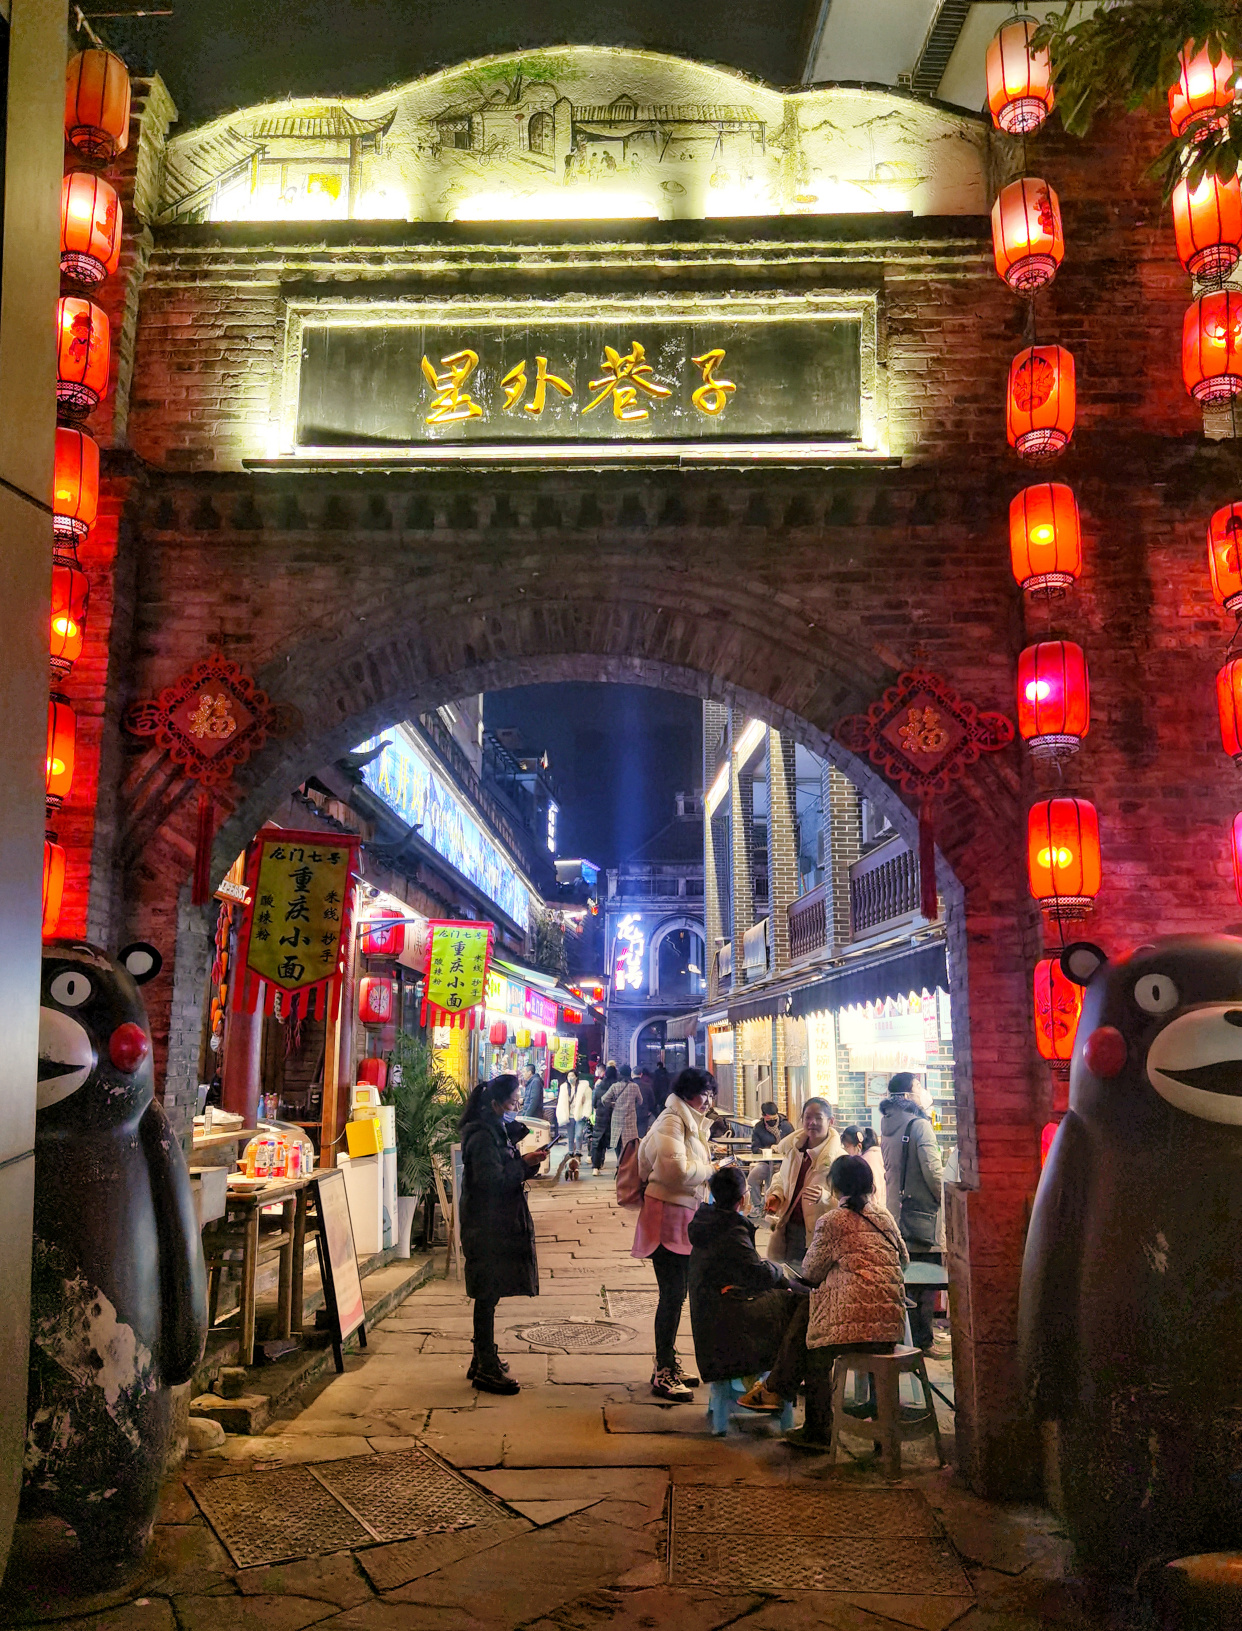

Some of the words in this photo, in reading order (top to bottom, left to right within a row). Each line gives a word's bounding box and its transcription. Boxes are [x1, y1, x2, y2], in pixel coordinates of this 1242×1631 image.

[421, 341, 736, 425] 里外巷子
[269, 847, 341, 865] 龙门七号
[255, 894, 276, 942] 酸辣粉
[323, 889, 341, 922] 米线
[277, 866, 313, 981] 重庆小面
[438, 930, 482, 940] 龙门七号
[320, 932, 337, 962] 抄手
[616, 914, 644, 990] 龙门七号
[432, 958, 444, 986] 酸辣粉
[446, 940, 466, 1008] 重庆小面
[472, 954, 483, 973] 米线
[470, 978, 481, 997] 抄手
